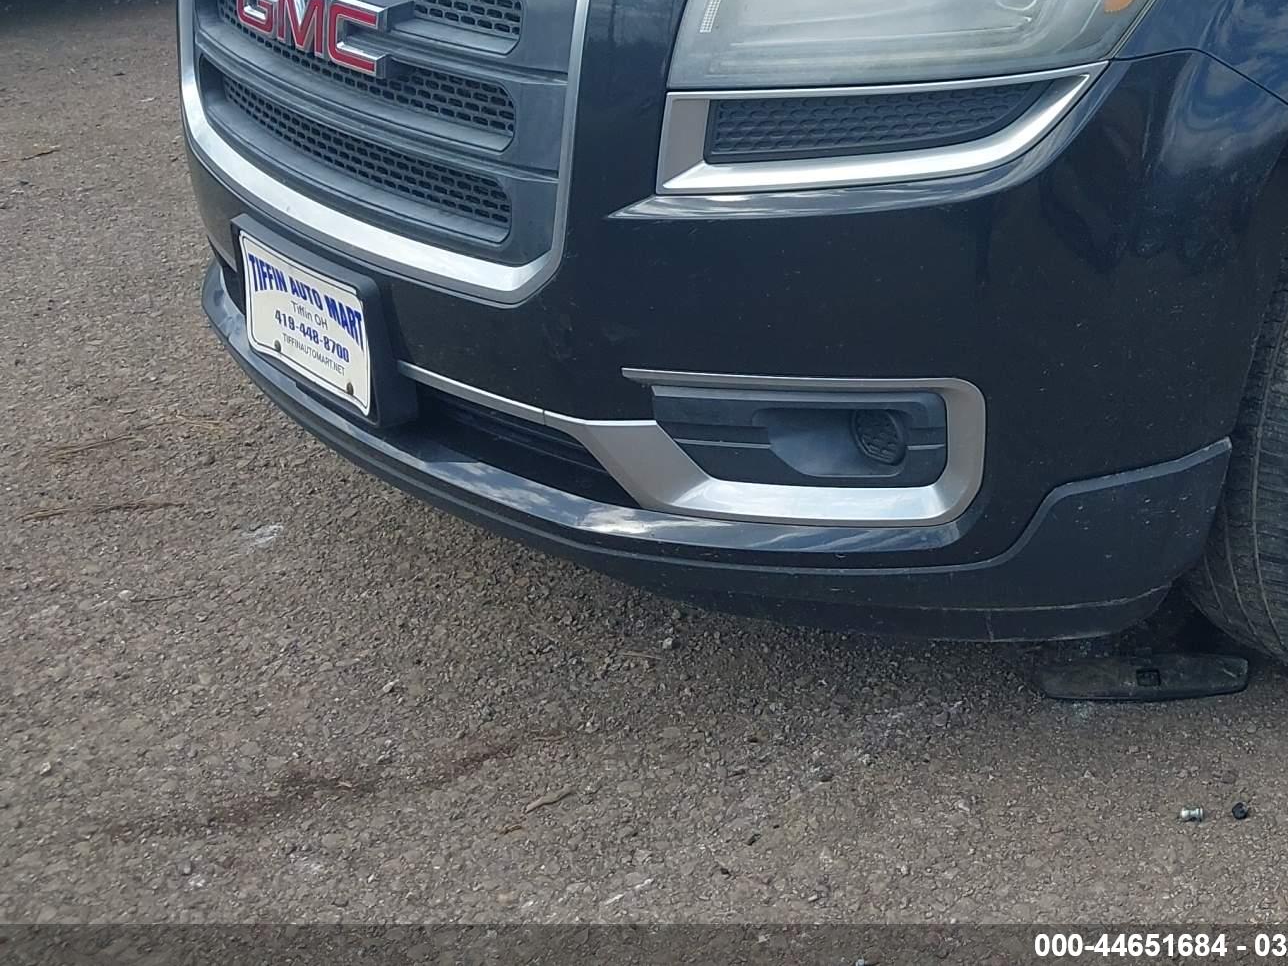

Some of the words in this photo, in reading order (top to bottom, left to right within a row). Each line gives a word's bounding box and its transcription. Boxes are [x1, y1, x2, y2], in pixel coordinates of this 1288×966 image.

[248, 253, 288, 293] TIFFIN
[289, 275, 324, 311] AUTO
[324, 294, 364, 353] MART
[291, 300, 313, 322] Tiffin
[314, 314, 328, 330] OH
[282, 333, 345, 376] TIFFINAUTOMART.NET
